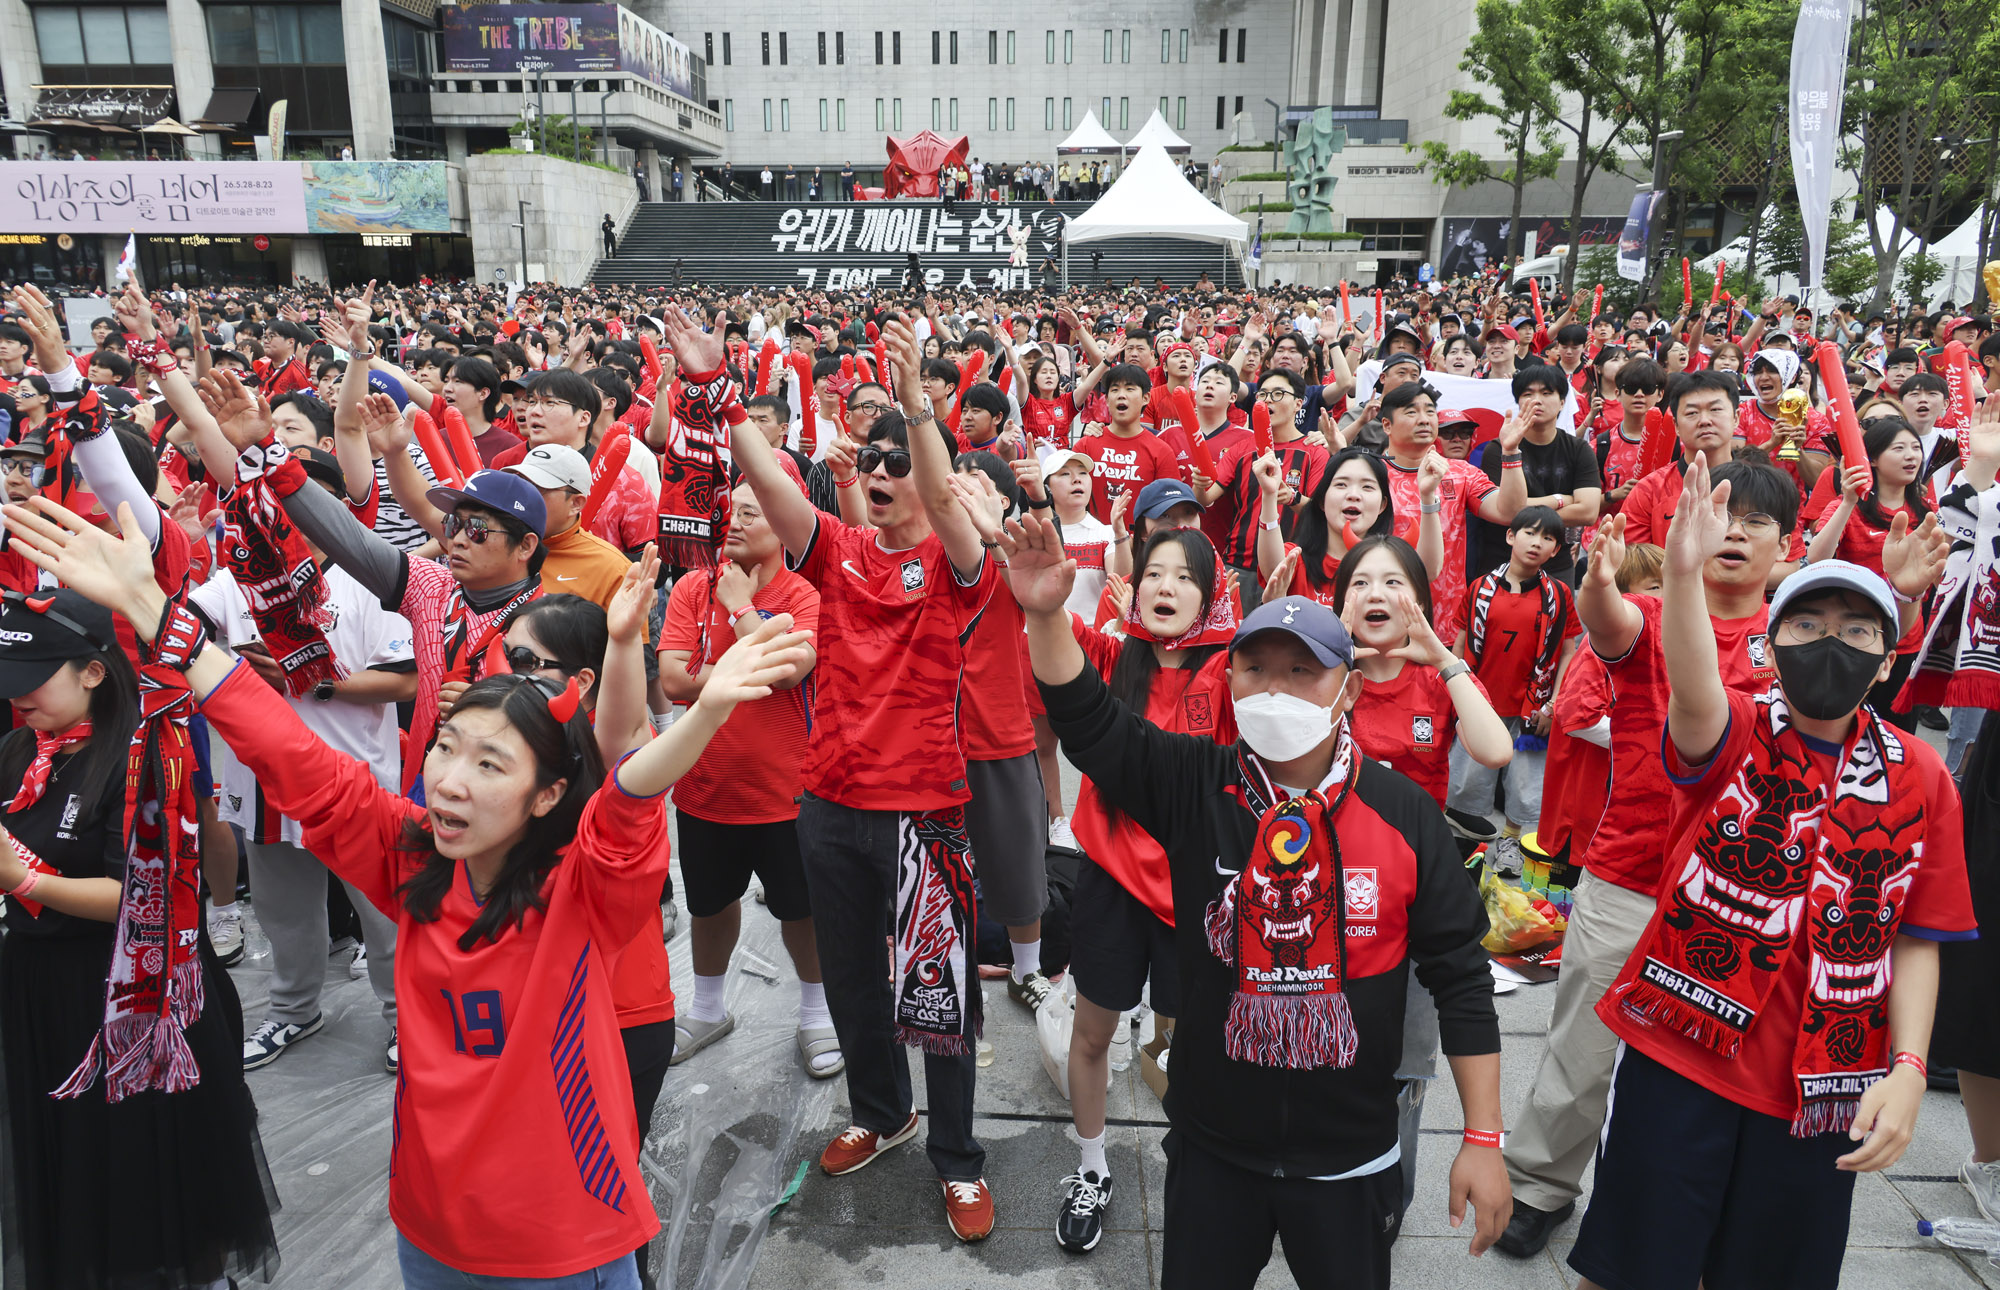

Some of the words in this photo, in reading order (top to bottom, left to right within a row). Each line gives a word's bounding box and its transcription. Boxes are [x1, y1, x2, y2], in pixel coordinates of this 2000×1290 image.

[479, 25, 512, 49] THE
[513, 17, 584, 50] TRIBE
[224, 181, 273, 189] 26.5.28-8.23
[160, 174, 219, 221] 넘어
[196, 208, 231, 216] 디트로이트
[232, 208, 253, 216] 미술관
[771, 208, 854, 252] 우리가
[855, 208, 964, 252] 깨어나는
[968, 208, 1023, 252] 순간
[20, 235, 42, 244] HOUSE
[1100, 447, 1137, 465] Red
[904, 591, 928, 602] KOREA
[491, 601, 518, 628] BRING
[1502, 630, 1519, 653] 7
[1753, 671, 1775, 680] KORE
[1344, 926, 1377, 937] KOREA
[1245, 966, 1283, 982] Red
[1257, 982, 1325, 992] DAEHANMINKOOK
[440, 987, 508, 1059] 19
